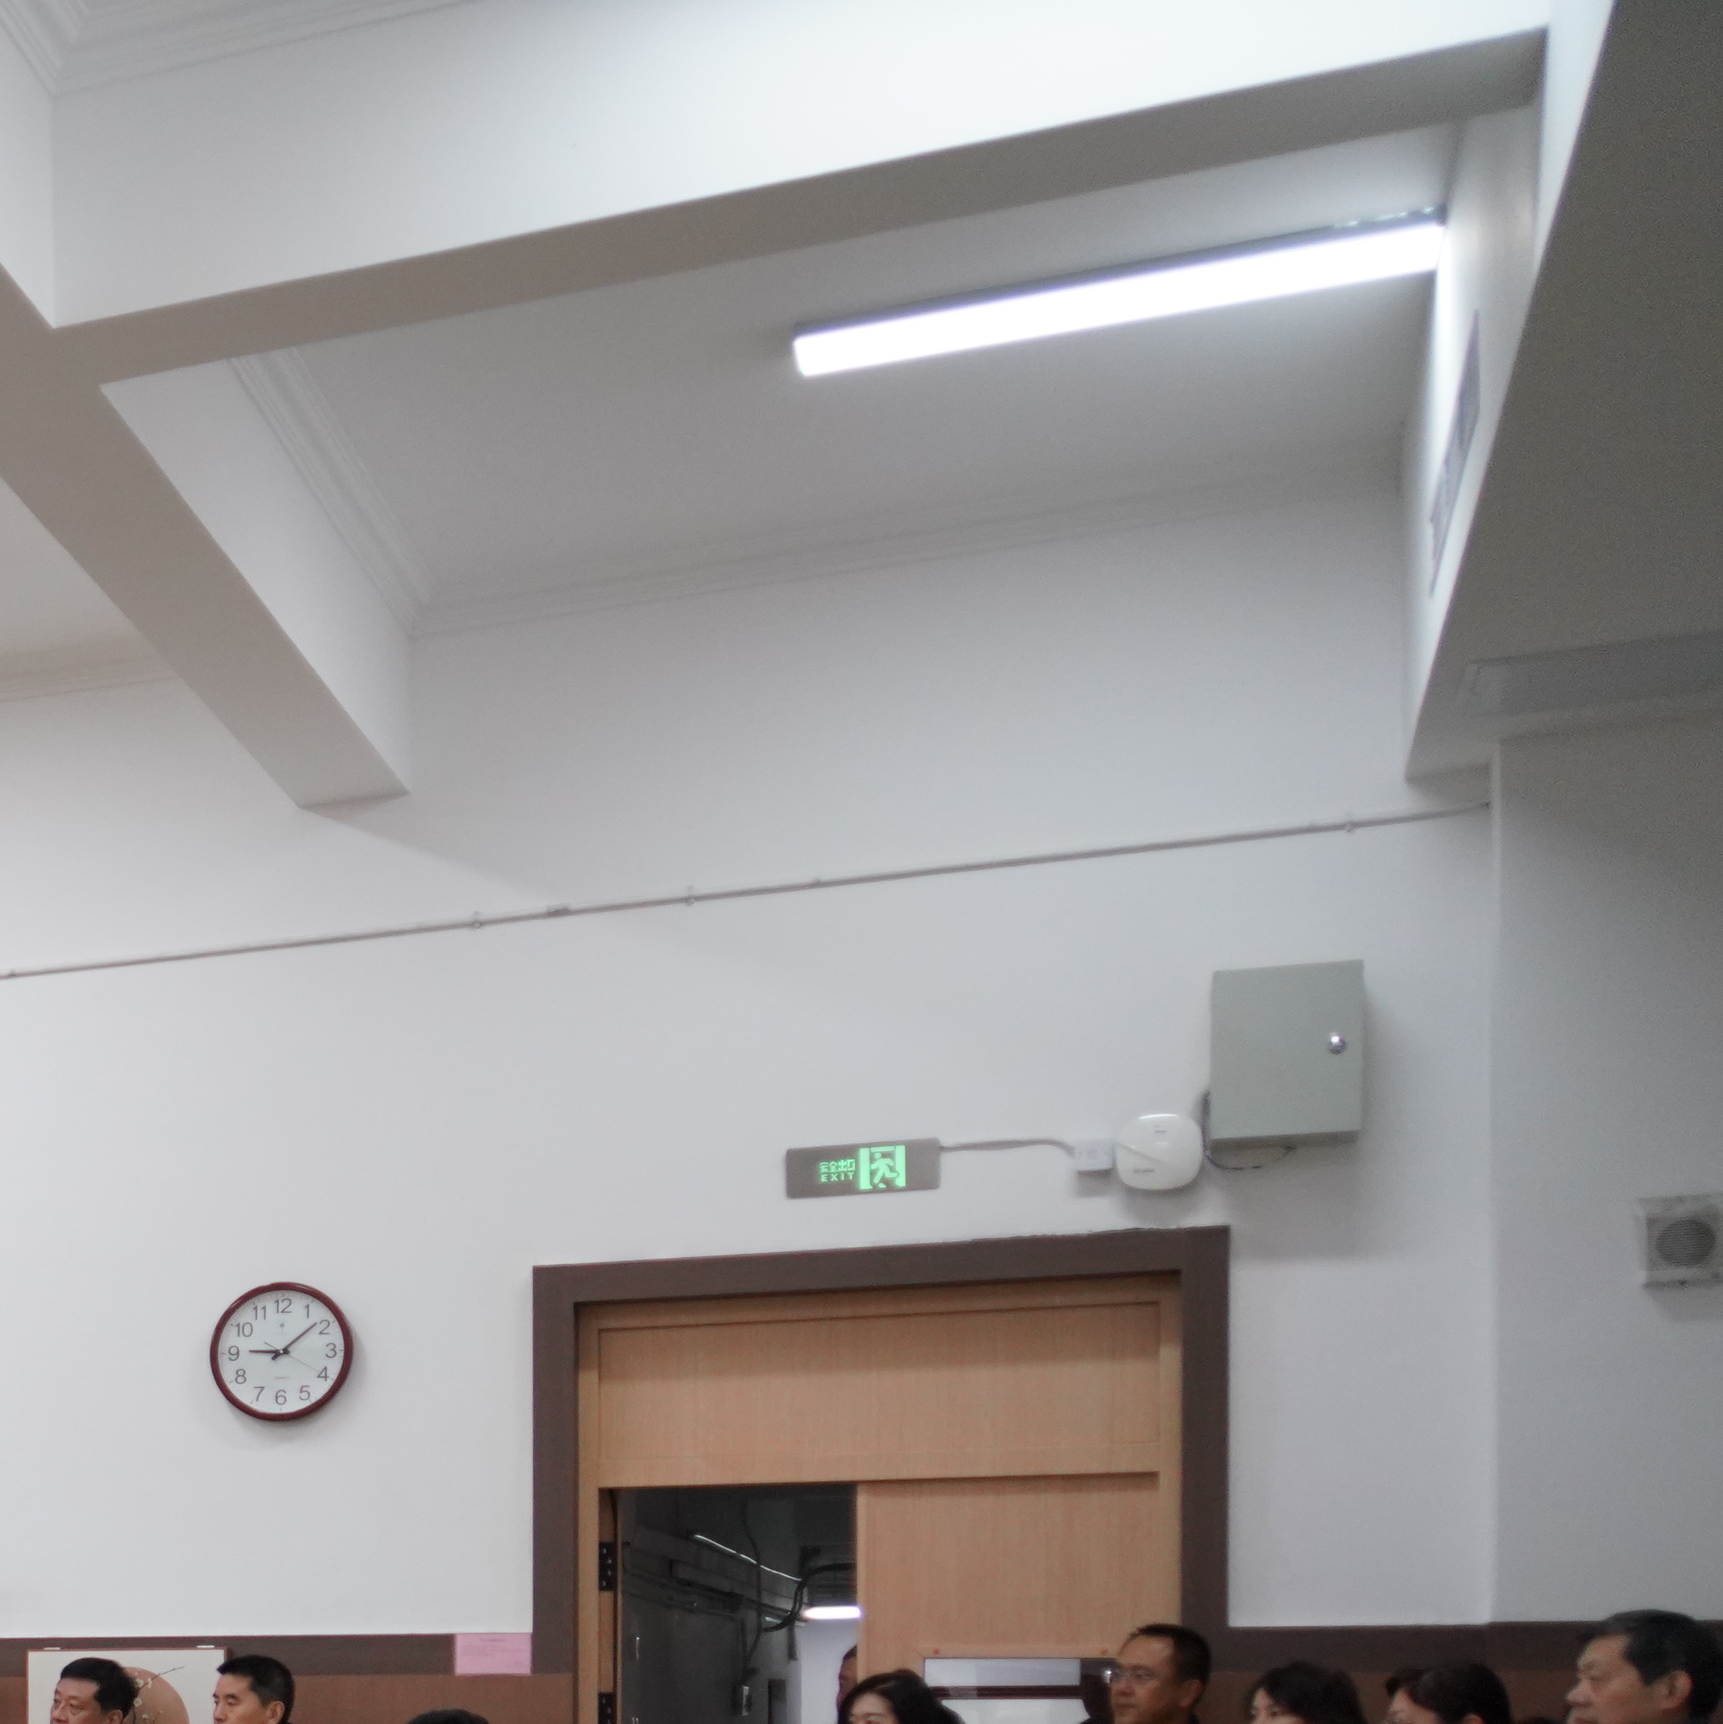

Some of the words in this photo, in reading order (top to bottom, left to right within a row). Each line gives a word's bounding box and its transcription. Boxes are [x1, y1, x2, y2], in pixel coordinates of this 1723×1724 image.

[819, 1159, 855, 1173] 安全出口
[821, 1172, 855, 1182] EXIT
[253, 1305, 267, 1320] 11
[274, 1298, 292, 1314] 12
[305, 1303, 310, 1319] 1
[235, 1322, 253, 1337] 10
[318, 1319, 331, 1335] 2
[228, 1345, 240, 1361] 9
[325, 1343, 337, 1358] 3
[235, 1368, 247, 1384] 8
[317, 1366, 329, 1382] 4
[254, 1386, 265, 1402] 7
[275, 1389, 287, 1405] 6
[299, 1385, 311, 1401] 5
